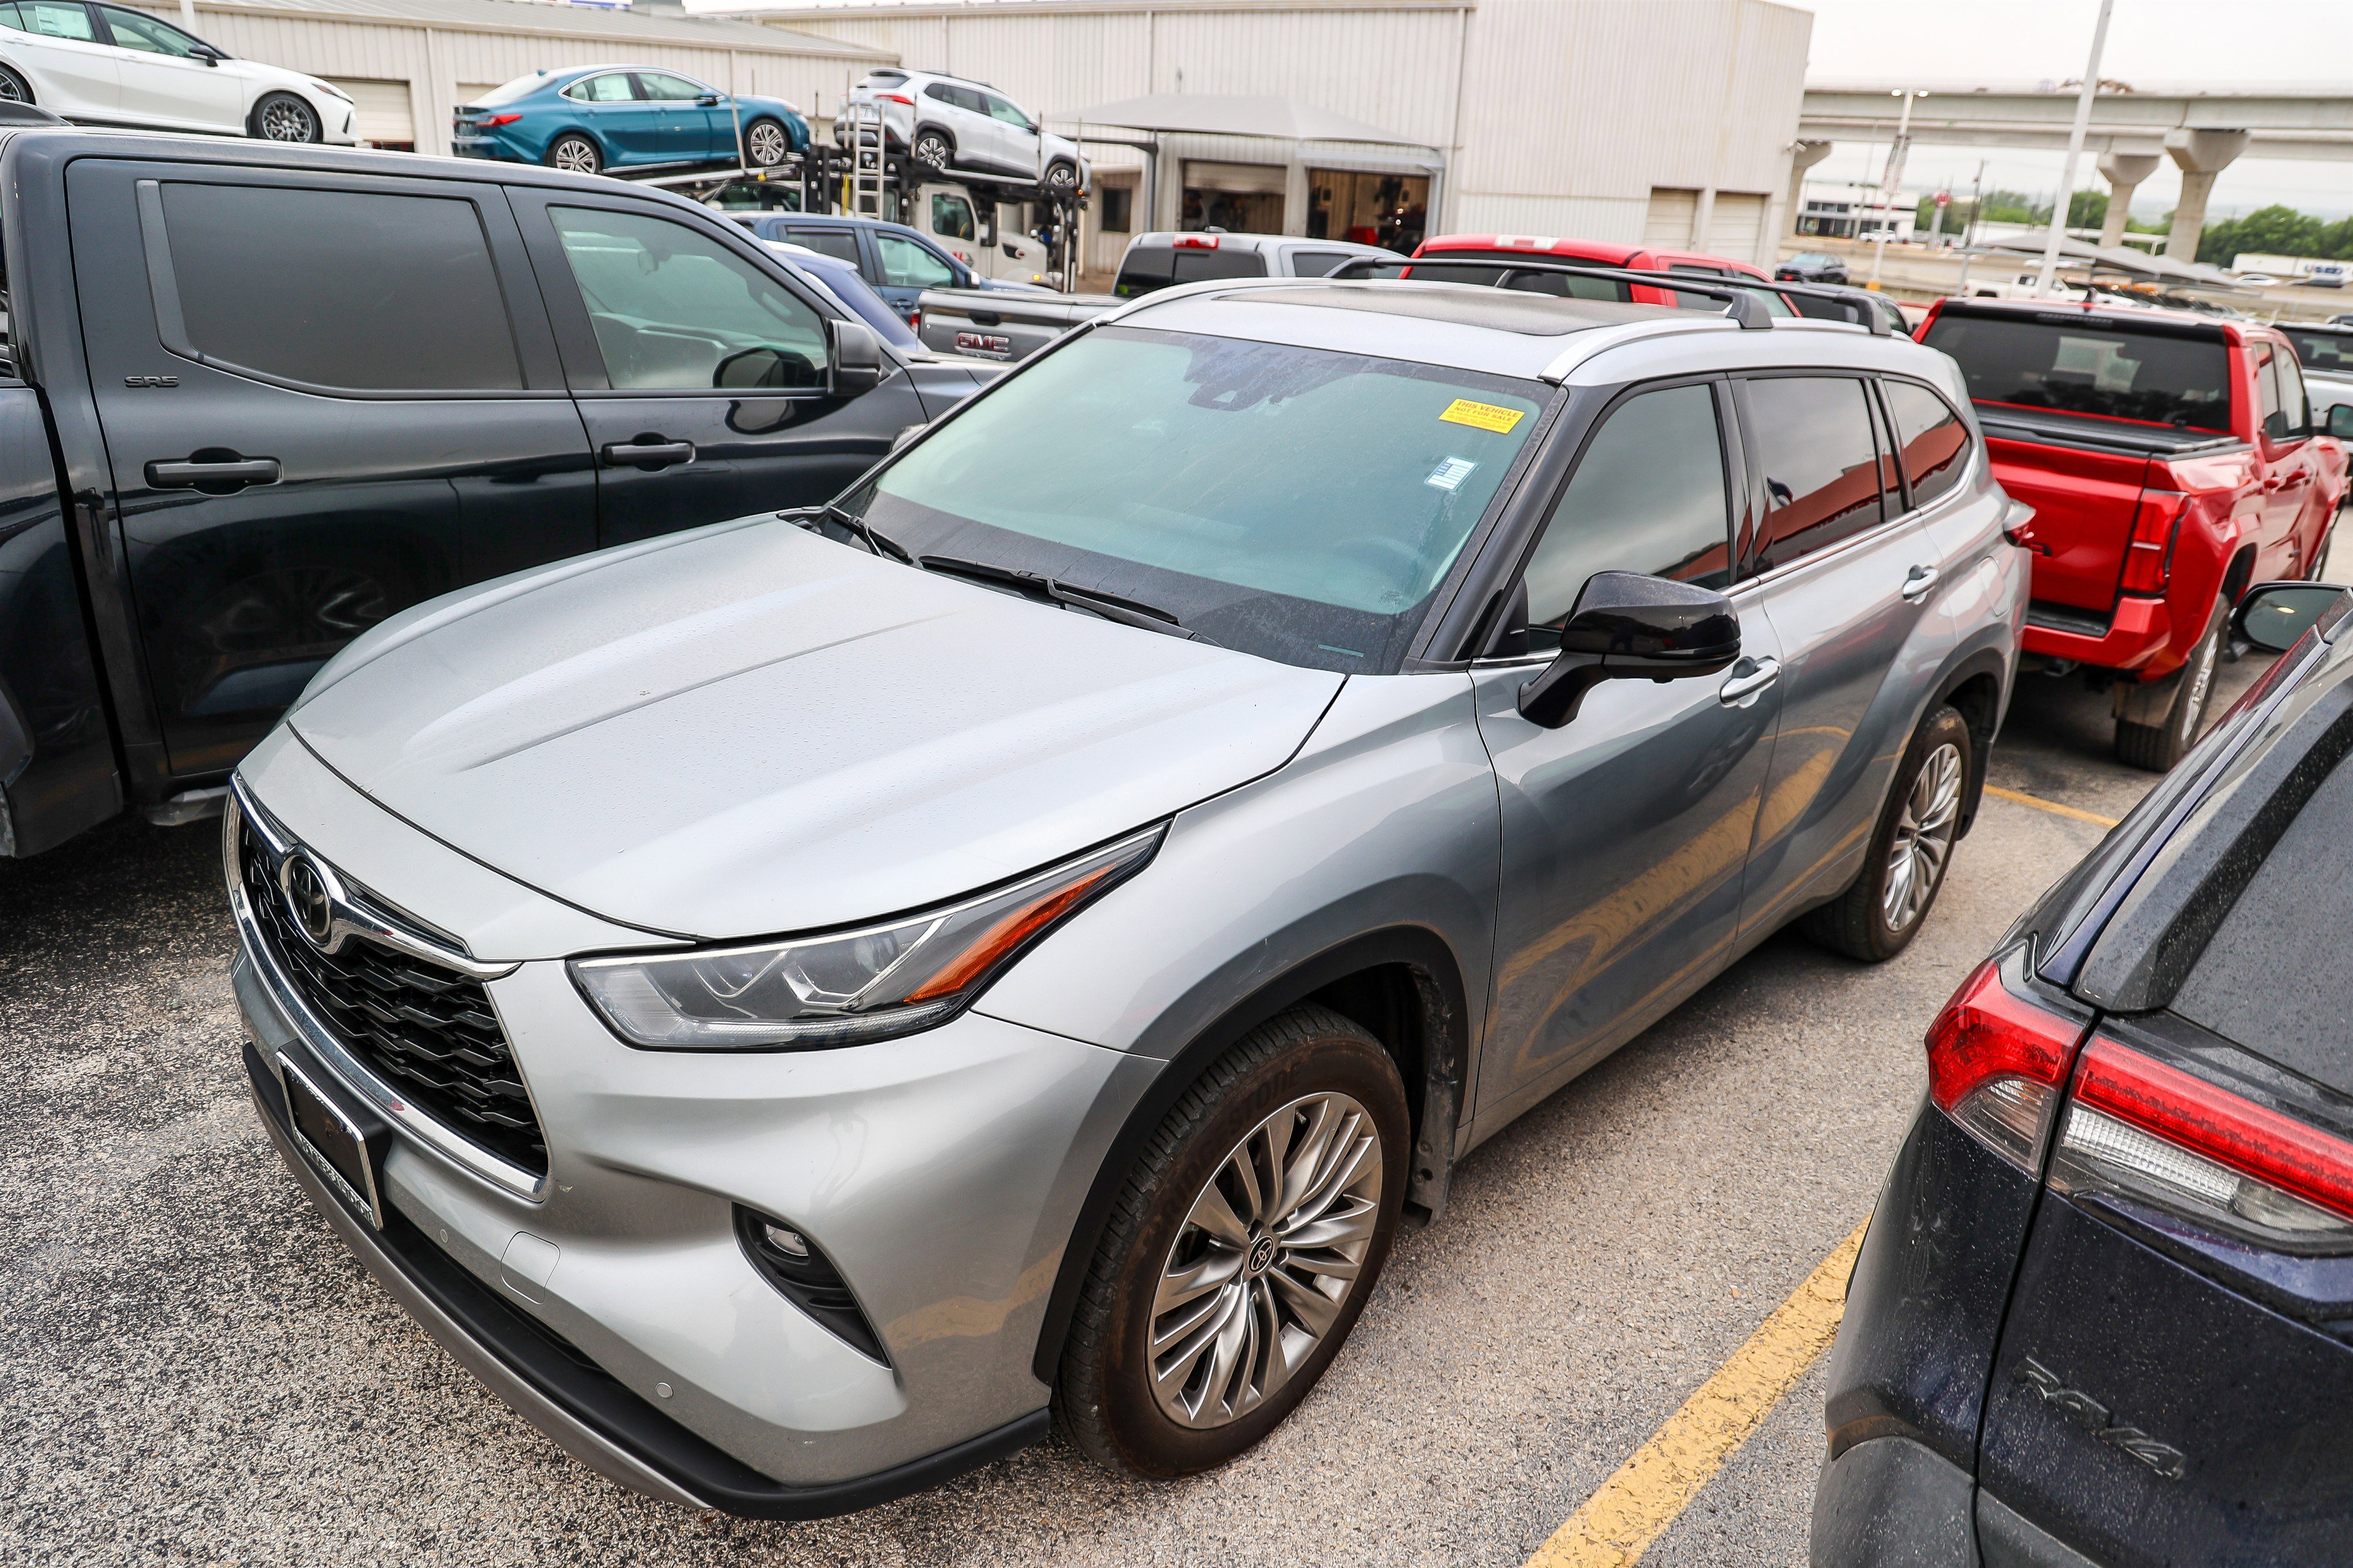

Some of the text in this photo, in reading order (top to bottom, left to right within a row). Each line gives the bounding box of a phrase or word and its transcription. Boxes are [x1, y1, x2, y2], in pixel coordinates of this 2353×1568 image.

[958, 333, 1009, 352] GMC
[124, 376, 179, 388] SR5
[1457, 400, 1520, 418] THIS VEHICLE
[342, 1184, 376, 1227] TOYOTA
[2012, 1356, 2187, 1481] RAV4
